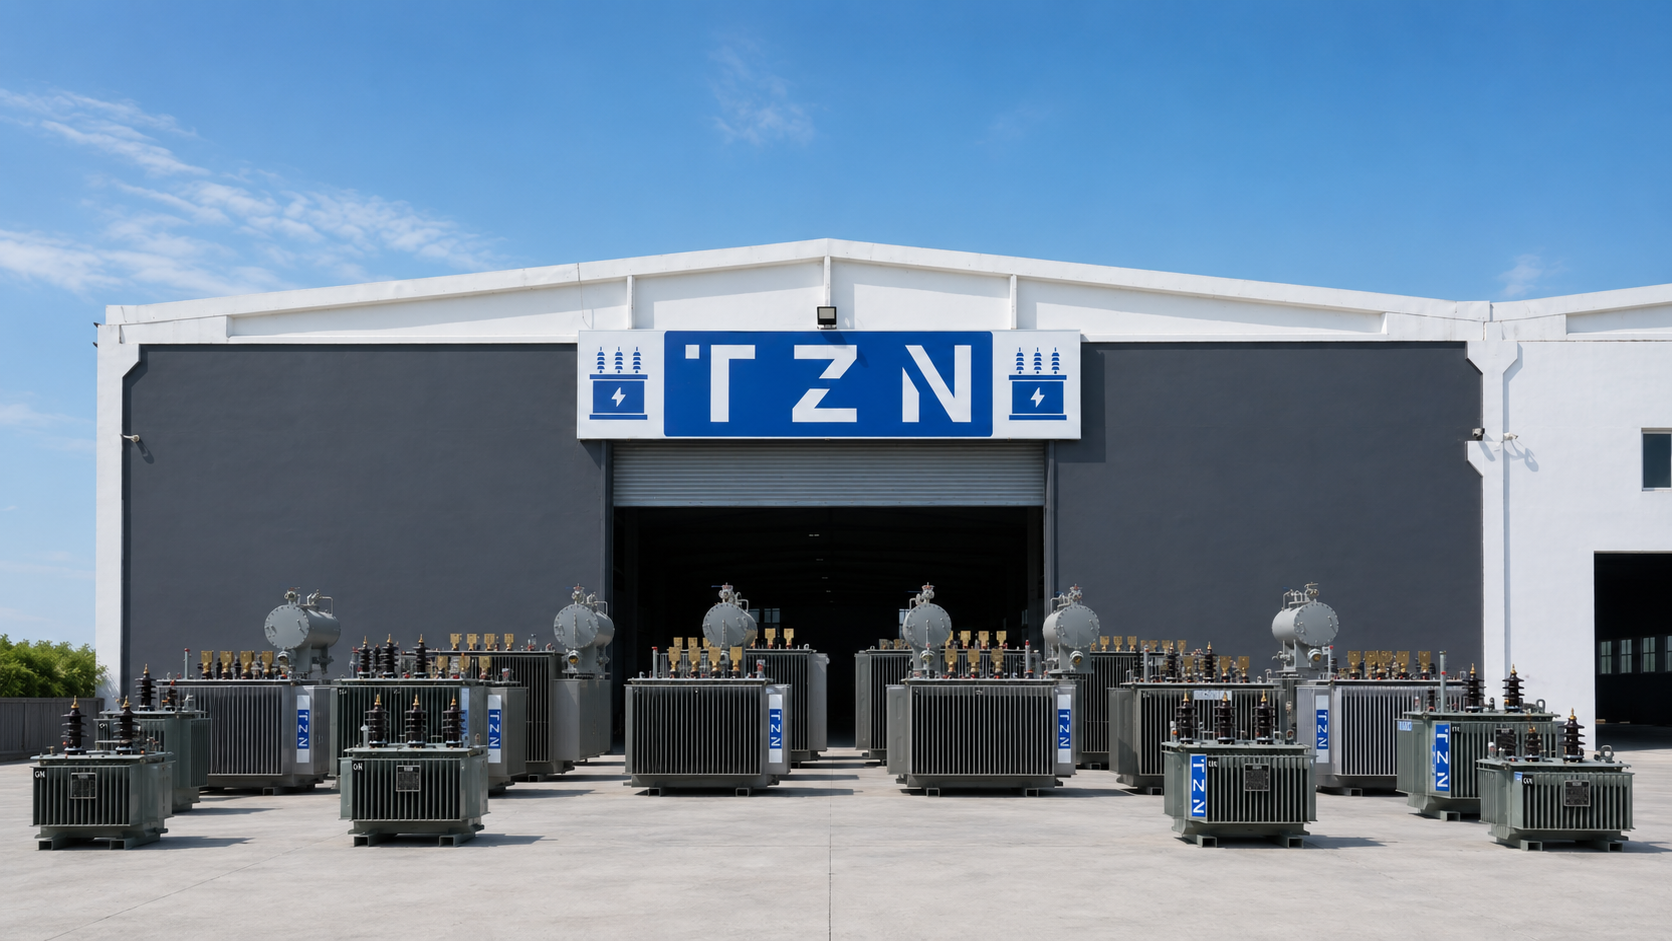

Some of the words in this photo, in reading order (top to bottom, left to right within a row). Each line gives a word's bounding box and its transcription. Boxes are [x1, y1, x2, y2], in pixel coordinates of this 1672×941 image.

[685, 345, 971, 422] TZN
[298, 712, 308, 747] TZN
[490, 712, 500, 747] TZN
[771, 712, 781, 747] TZN
[1059, 712, 1070, 747] TZN
[1317, 712, 1328, 747] TZN
[1437, 727, 1449, 788] TZN
[1193, 758, 1205, 814] TZN
